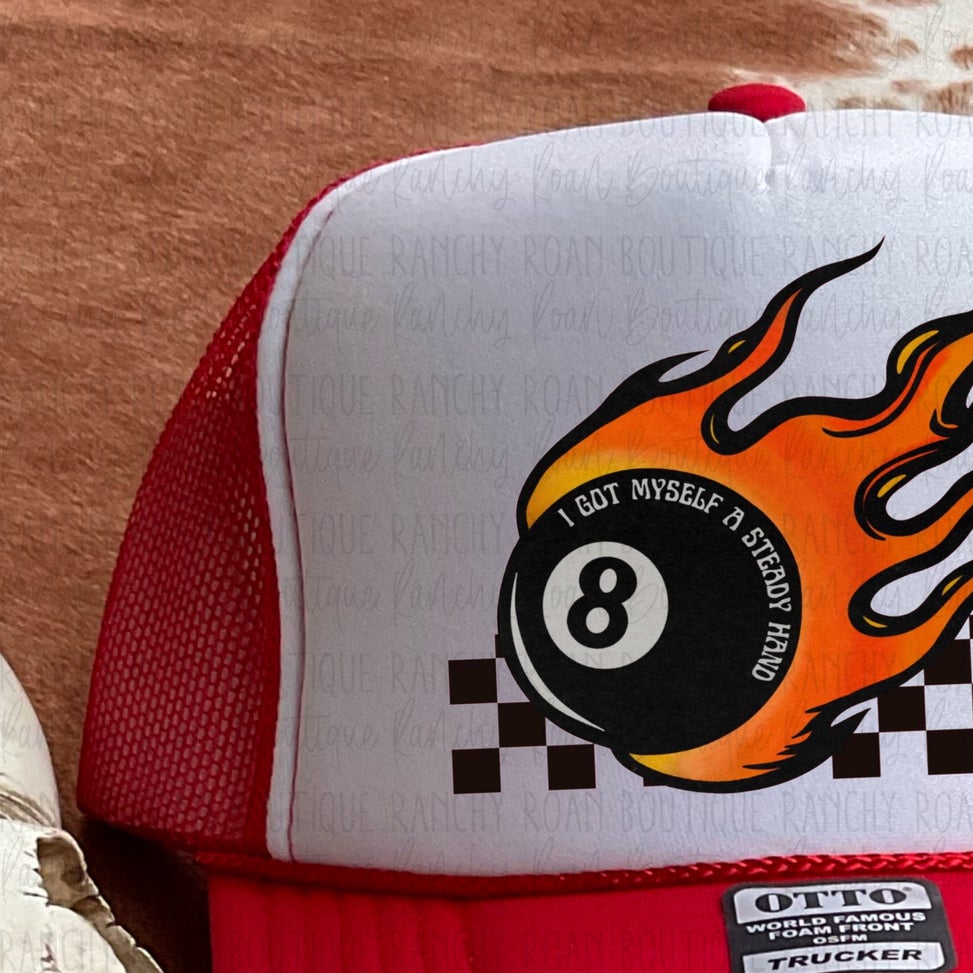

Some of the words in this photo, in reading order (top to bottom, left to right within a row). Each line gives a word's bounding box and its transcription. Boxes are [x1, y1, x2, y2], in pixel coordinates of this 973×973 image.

[574, 482, 620, 517] GOT
[631, 477, 724, 514] MYSELF
[557, 507, 575, 527] I
[722, 505, 745, 531] A
[741, 527, 792, 612] STEADY
[567, 557, 637, 649] 8
[751, 621, 791, 682] HAND
[755, 887, 907, 913] OTTO
[746, 915, 827, 934] WORLD
[833, 911, 926, 924] FAMOUS
[769, 925, 832, 941] FOAM
[838, 921, 914, 934] FRONT
[813, 933, 868, 945] OSFM
[767, 949, 922, 970] TRUCKER
